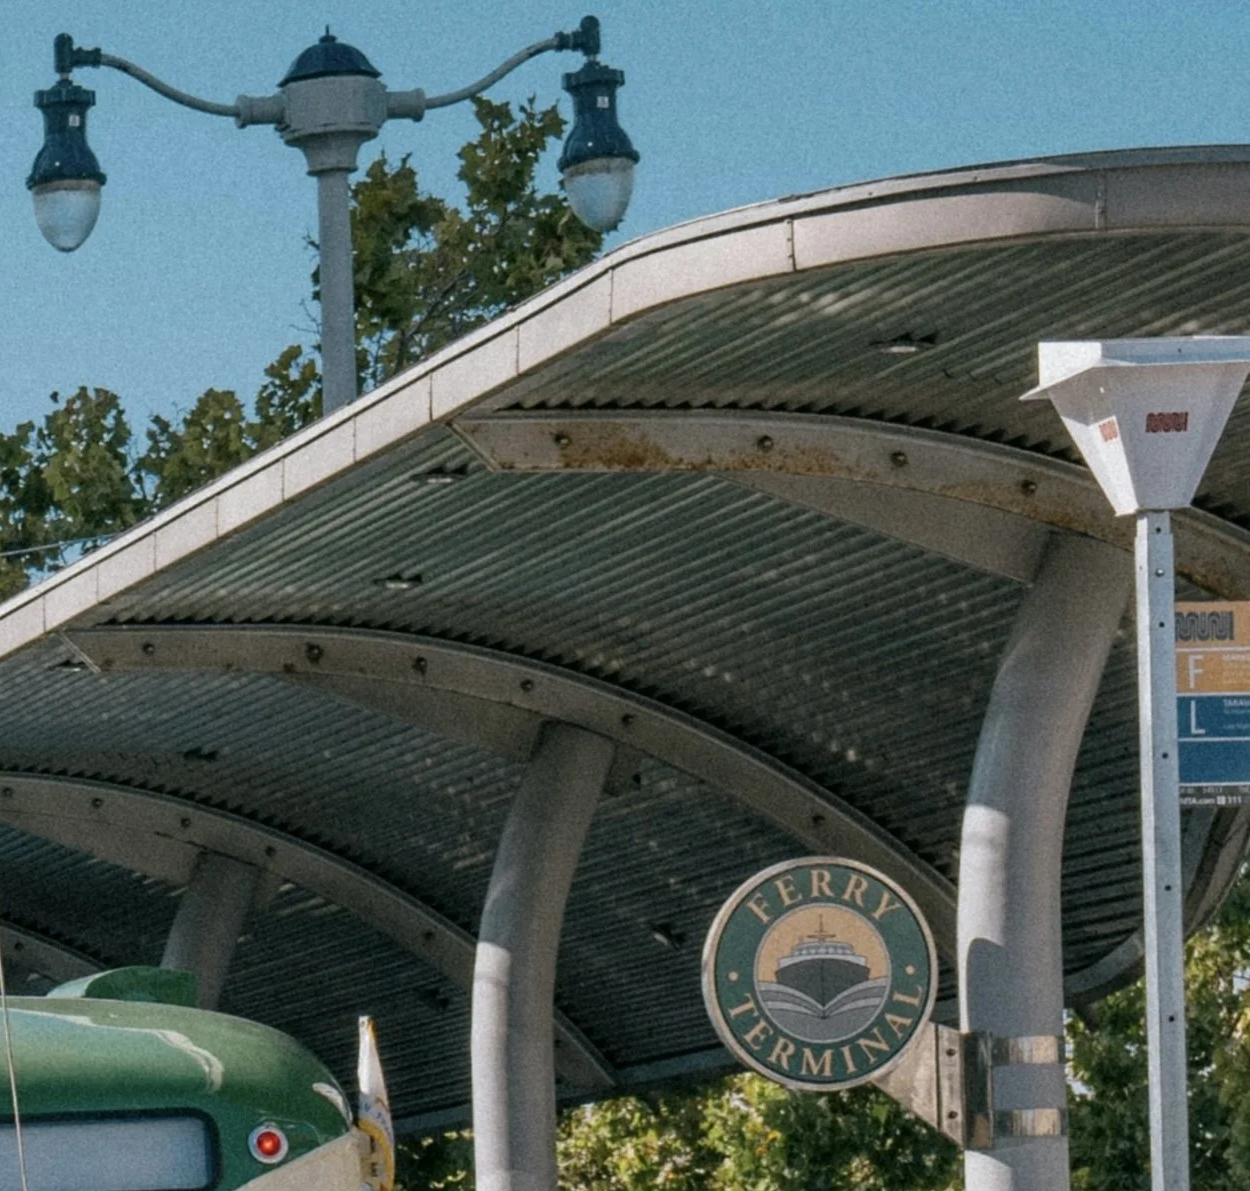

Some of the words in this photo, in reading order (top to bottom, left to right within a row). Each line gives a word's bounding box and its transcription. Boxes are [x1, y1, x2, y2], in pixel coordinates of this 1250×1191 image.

[1188, 654, 1204, 689] F
[1190, 699, 1206, 735] L
[747, 869, 902, 924] FERRY
[728, 984, 924, 1077] TERMINAL
